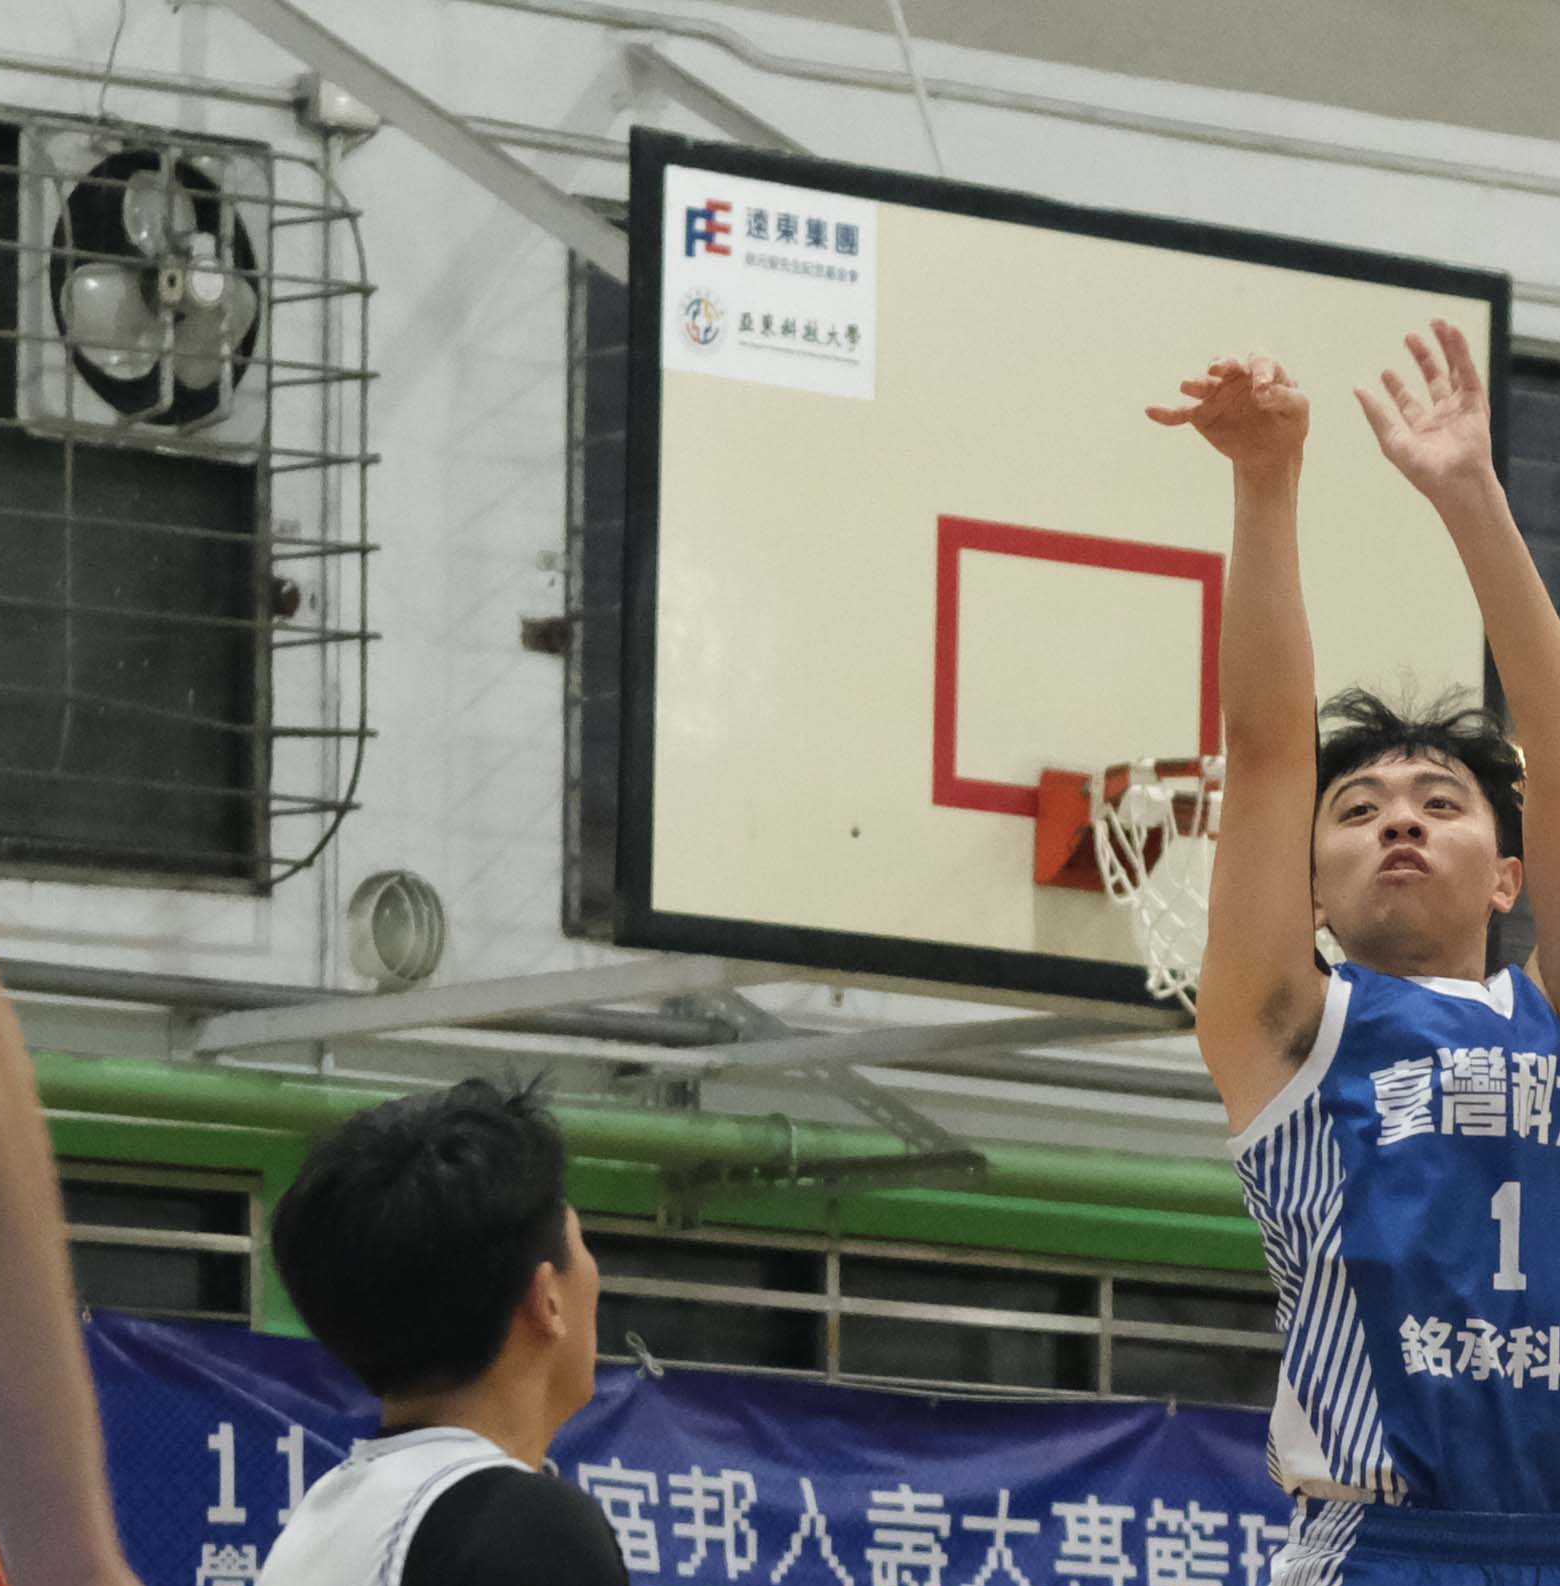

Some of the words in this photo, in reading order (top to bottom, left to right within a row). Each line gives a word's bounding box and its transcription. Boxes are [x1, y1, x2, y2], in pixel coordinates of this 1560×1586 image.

[745, 206, 860, 257] 遠東集團
[1490, 1181, 1528, 1291] 1
